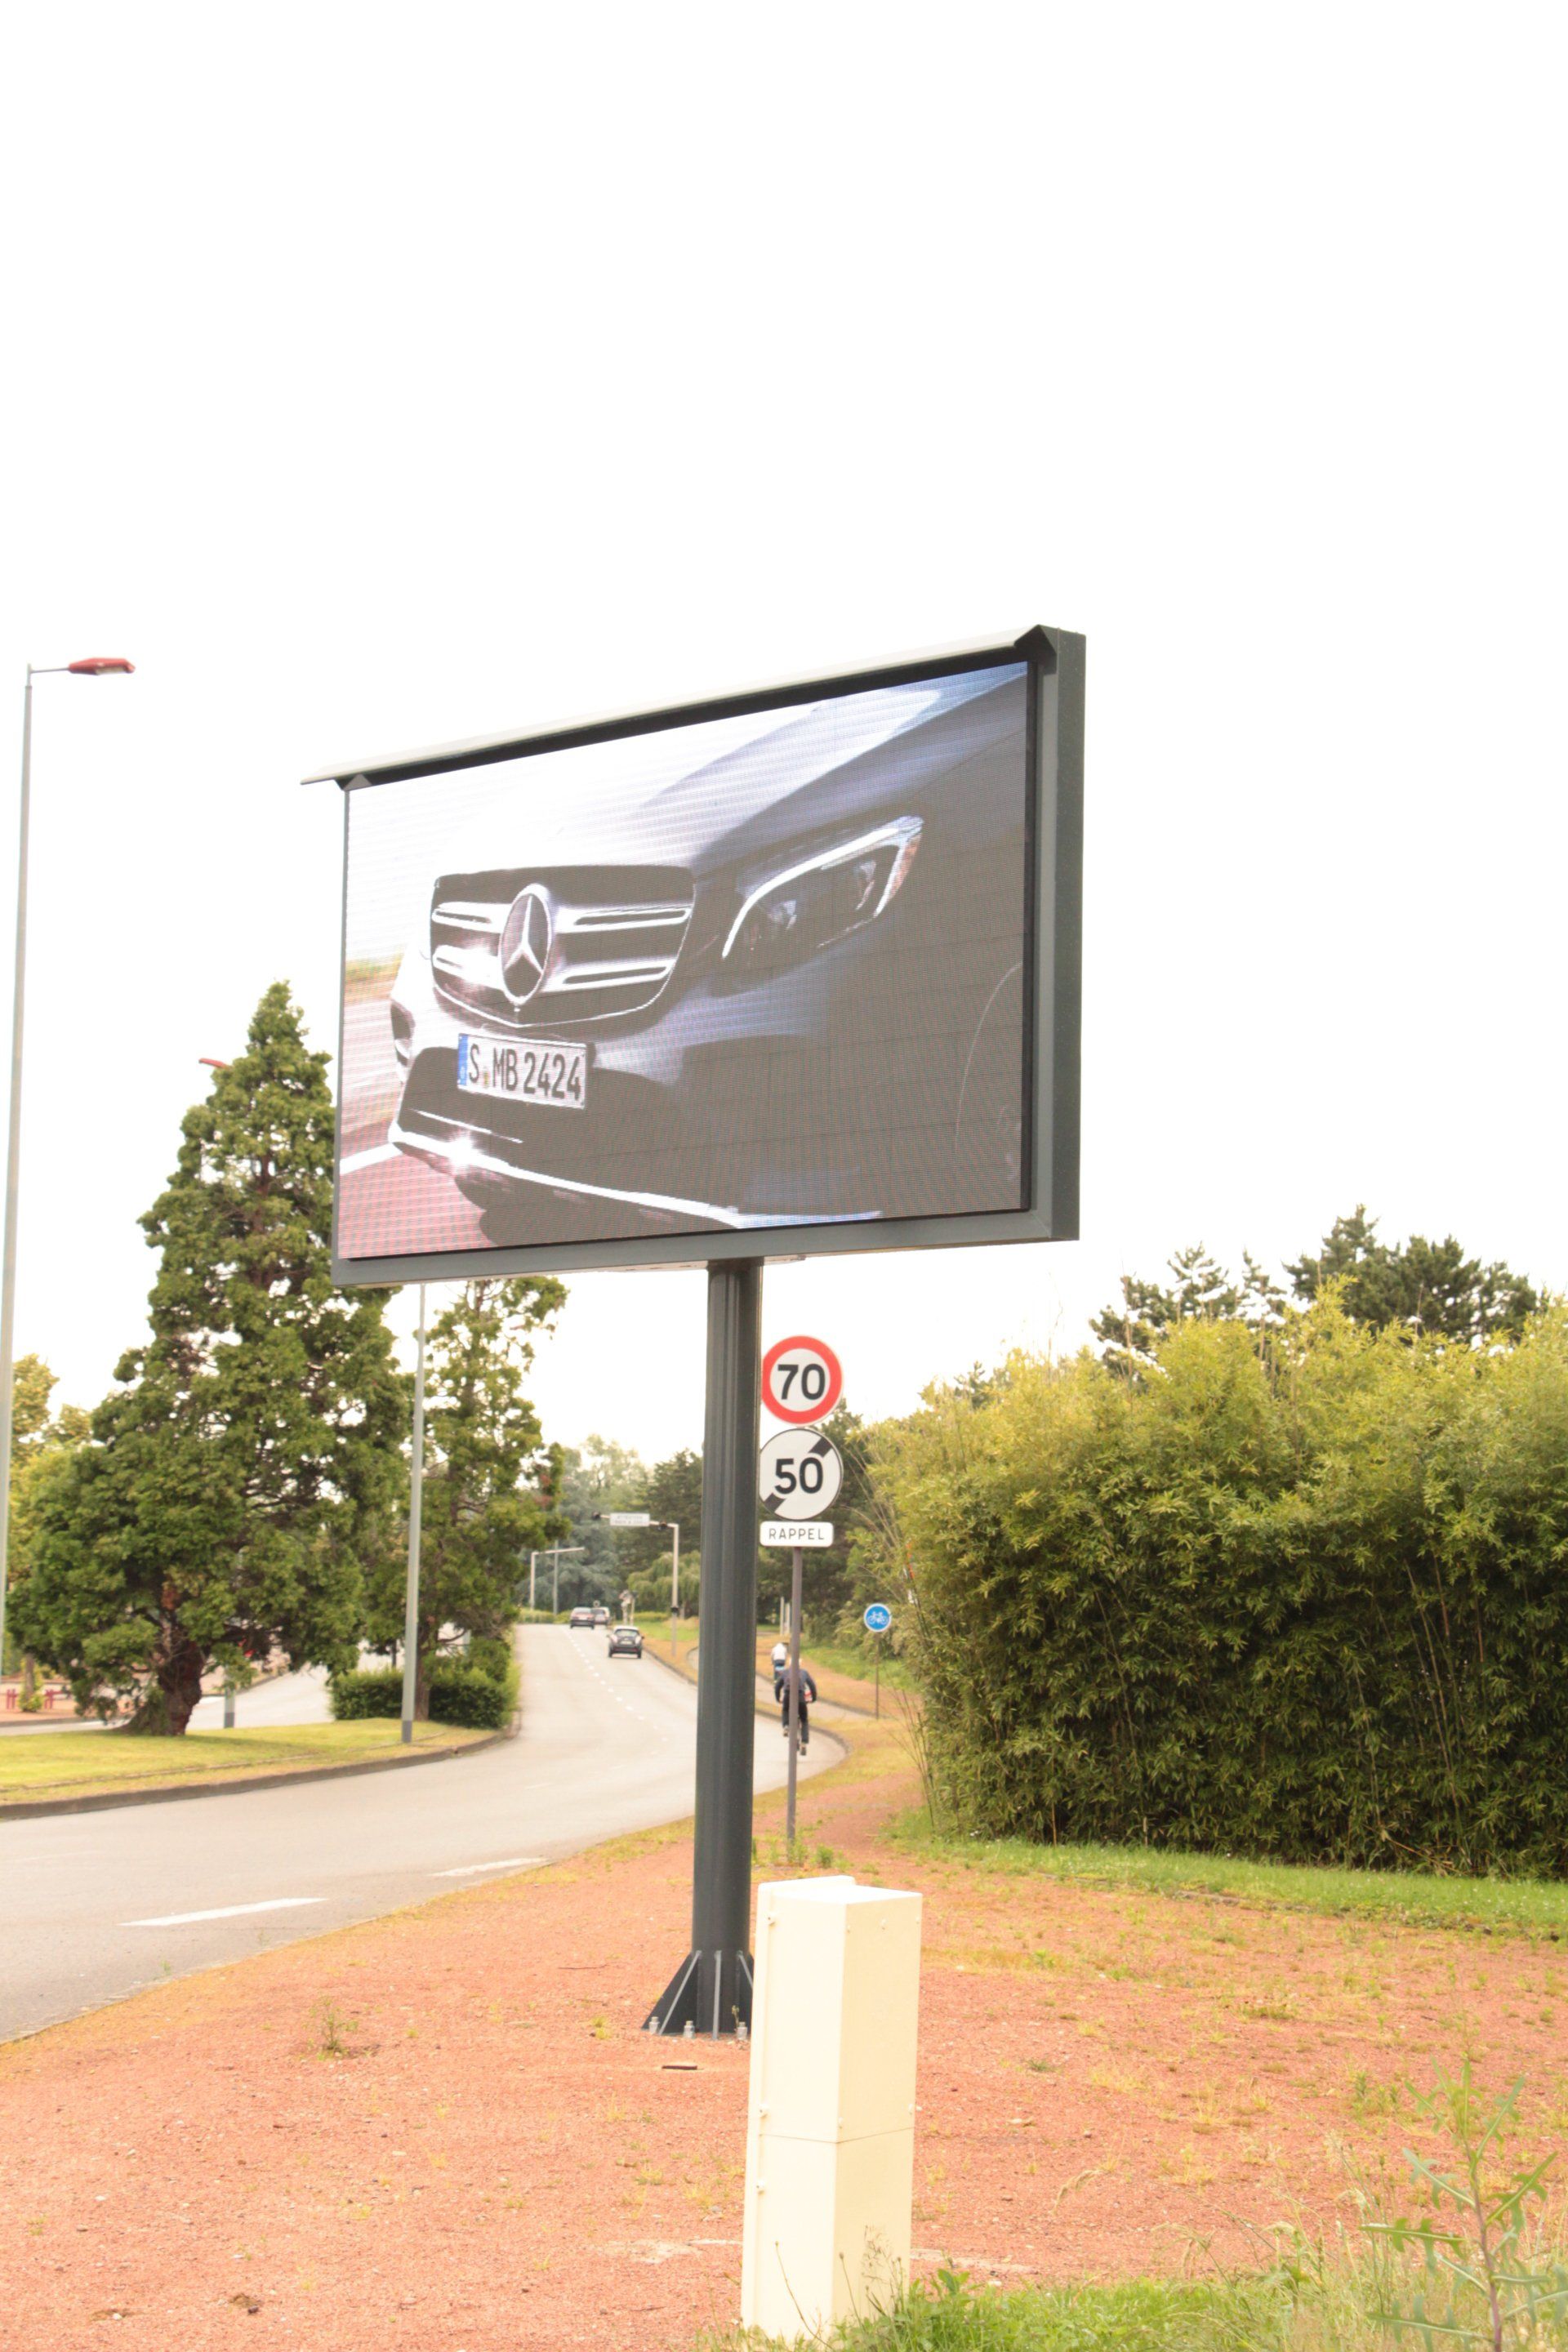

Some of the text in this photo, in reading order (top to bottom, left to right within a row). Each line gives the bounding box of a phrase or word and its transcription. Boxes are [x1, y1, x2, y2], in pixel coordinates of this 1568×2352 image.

[469, 1044, 581, 1101] S MB 2424
[777, 1363, 826, 1400] 70
[774, 1457, 823, 1494] 50
[768, 1528, 825, 1540] RAPPEL
